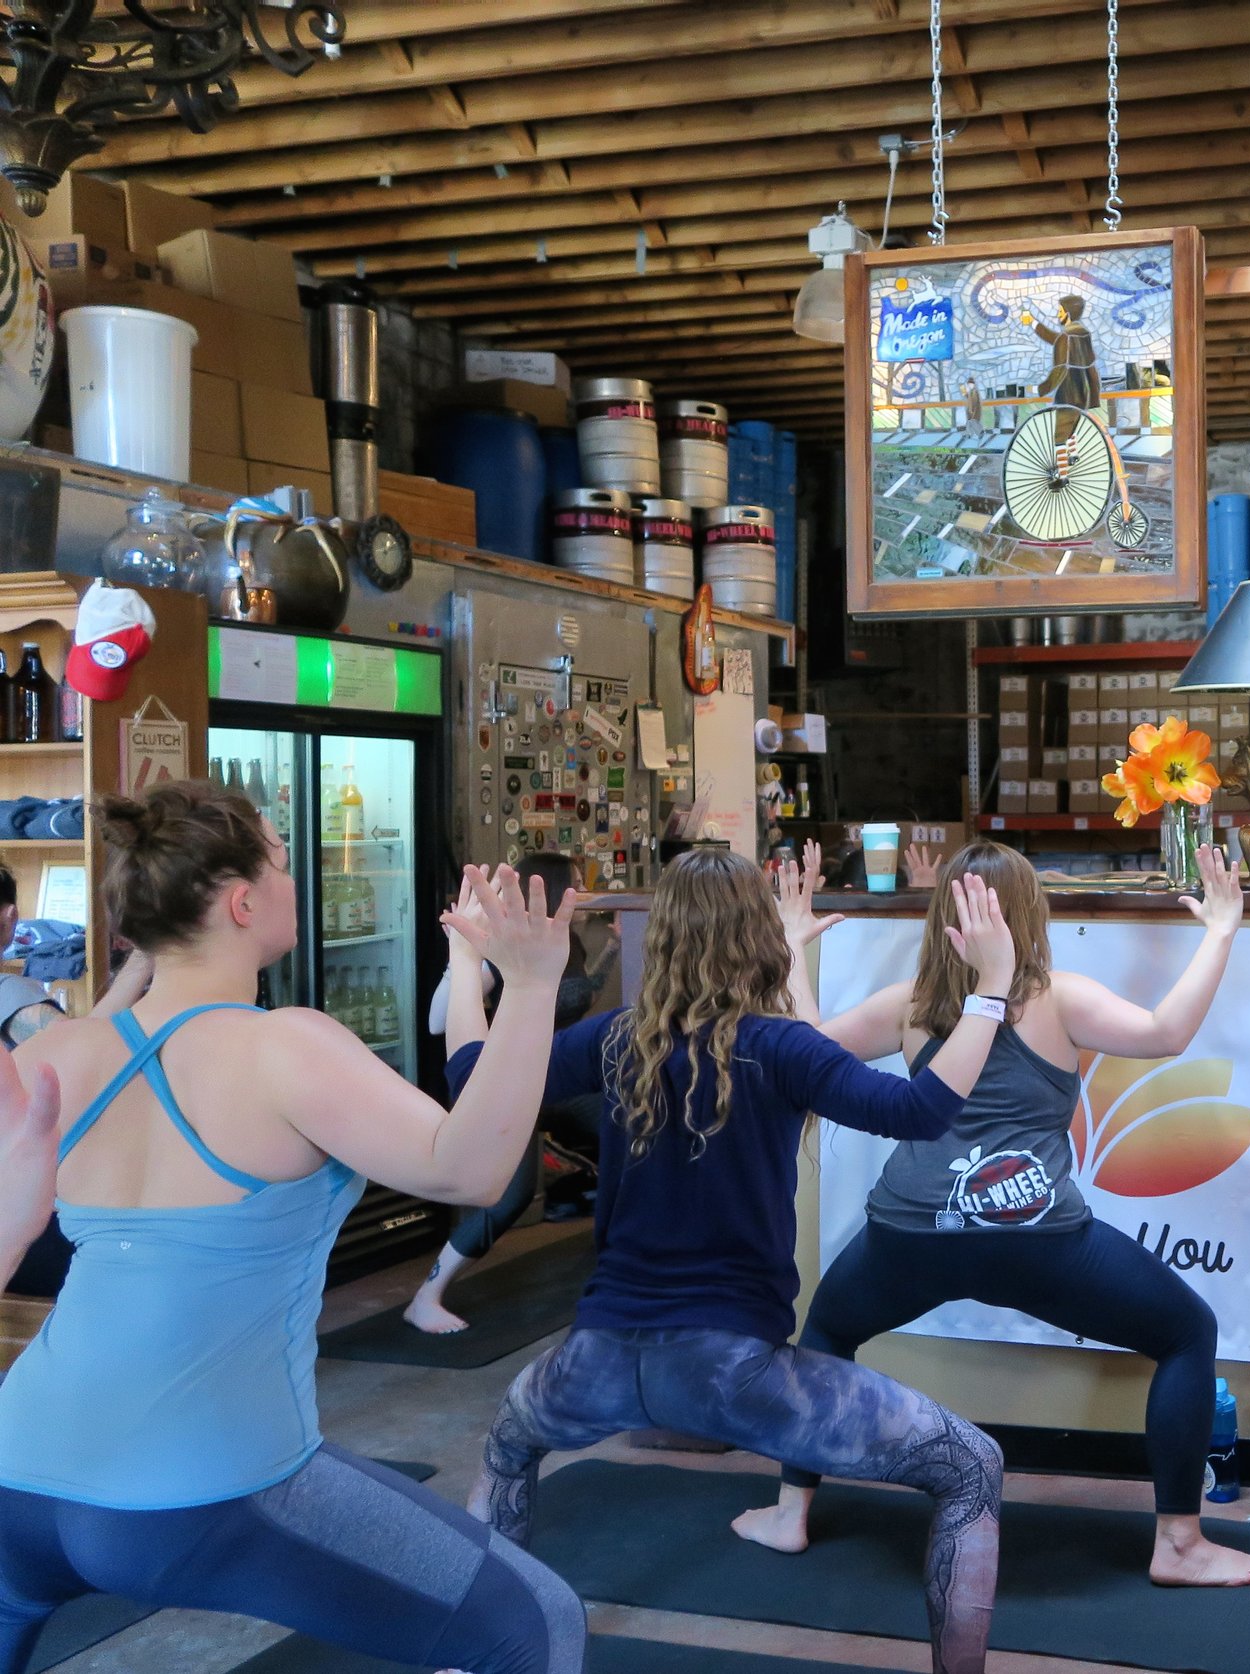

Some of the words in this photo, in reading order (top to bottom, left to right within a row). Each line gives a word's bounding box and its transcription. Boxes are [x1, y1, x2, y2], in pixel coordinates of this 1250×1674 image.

[883, 311, 929, 337] Made
[932, 309, 947, 323] in
[892, 329, 945, 355] Oregon
[132, 733, 181, 746] CLUTCH
[958, 1165, 1052, 1214] HI-WHEEL
[1007, 1195, 1033, 1210] WINE
